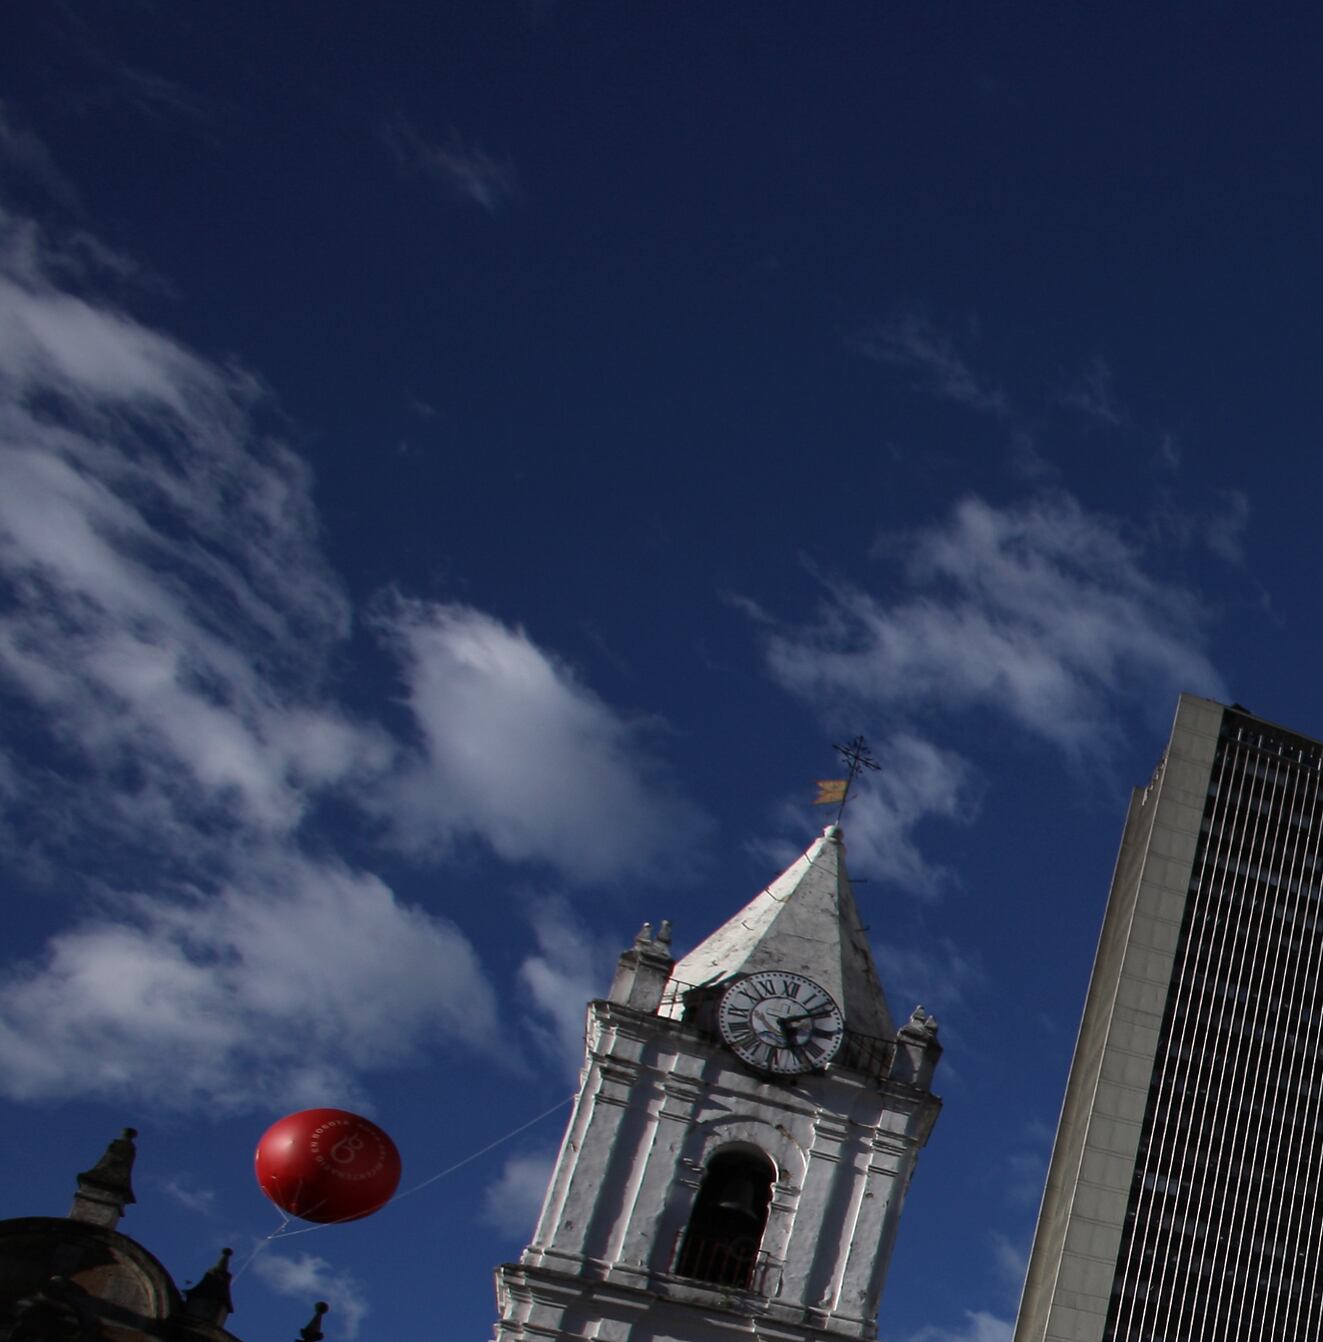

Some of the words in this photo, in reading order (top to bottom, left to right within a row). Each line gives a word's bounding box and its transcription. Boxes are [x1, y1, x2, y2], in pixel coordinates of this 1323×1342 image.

[738, 988, 758, 1004] X
[757, 979, 777, 996] XI
[781, 980, 800, 999] XII
